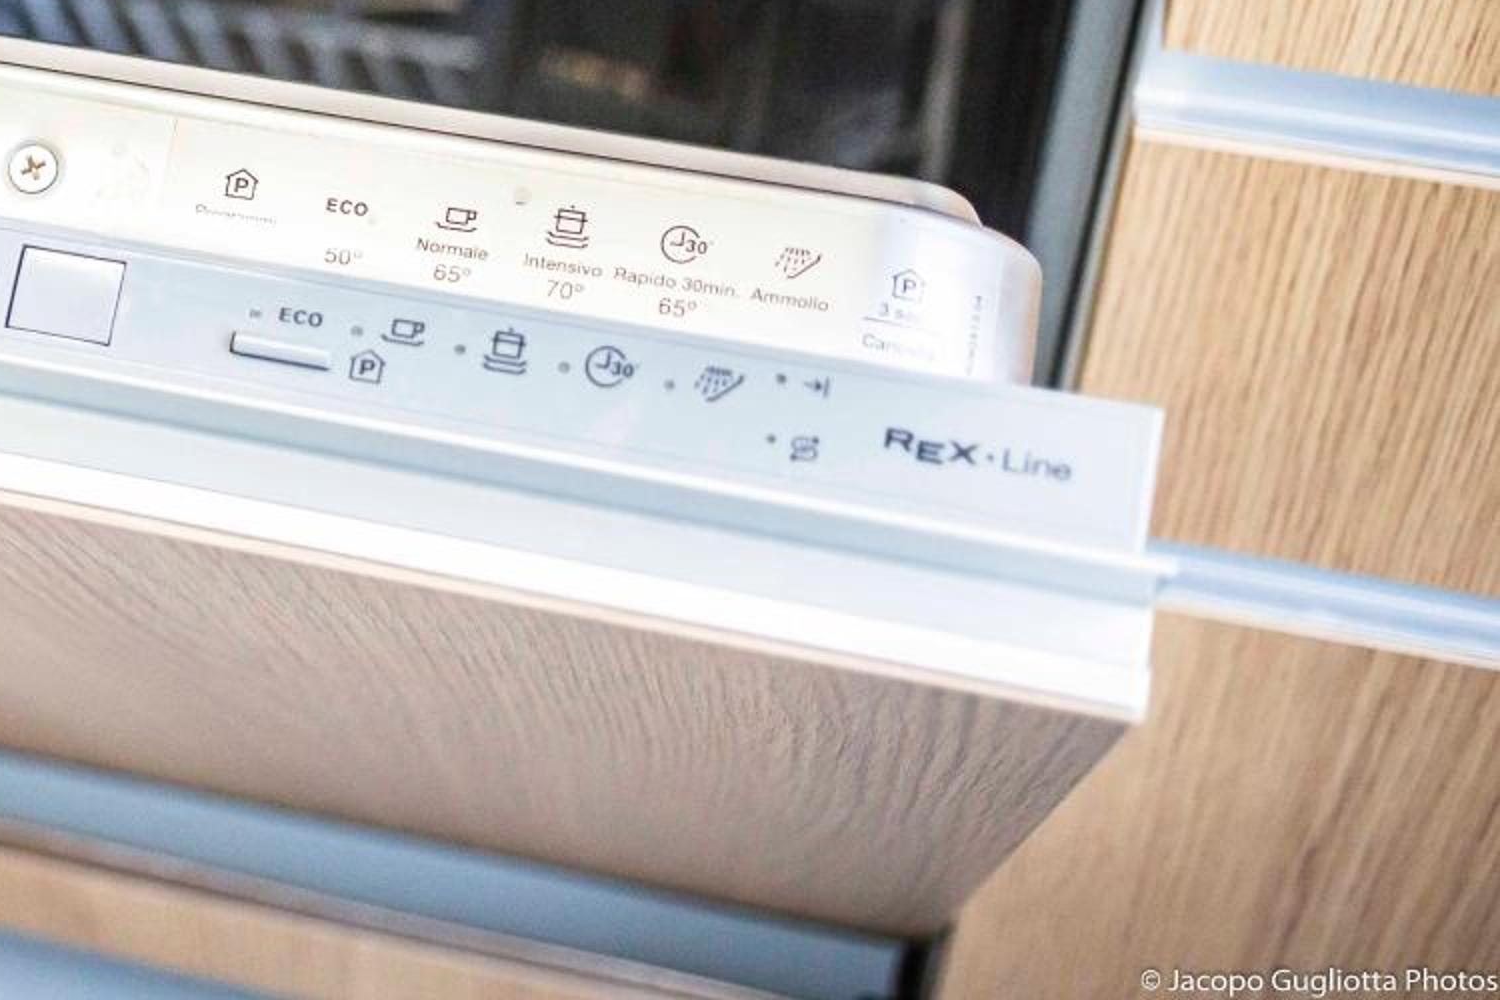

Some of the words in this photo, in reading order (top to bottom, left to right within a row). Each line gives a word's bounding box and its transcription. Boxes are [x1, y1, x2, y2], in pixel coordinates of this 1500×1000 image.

[326, 197, 368, 217] ECO
[415, 237, 488, 260] Normale
[523, 252, 603, 277] Intensivo
[613, 266, 677, 288] Rapido
[279, 306, 323, 328] ECO
